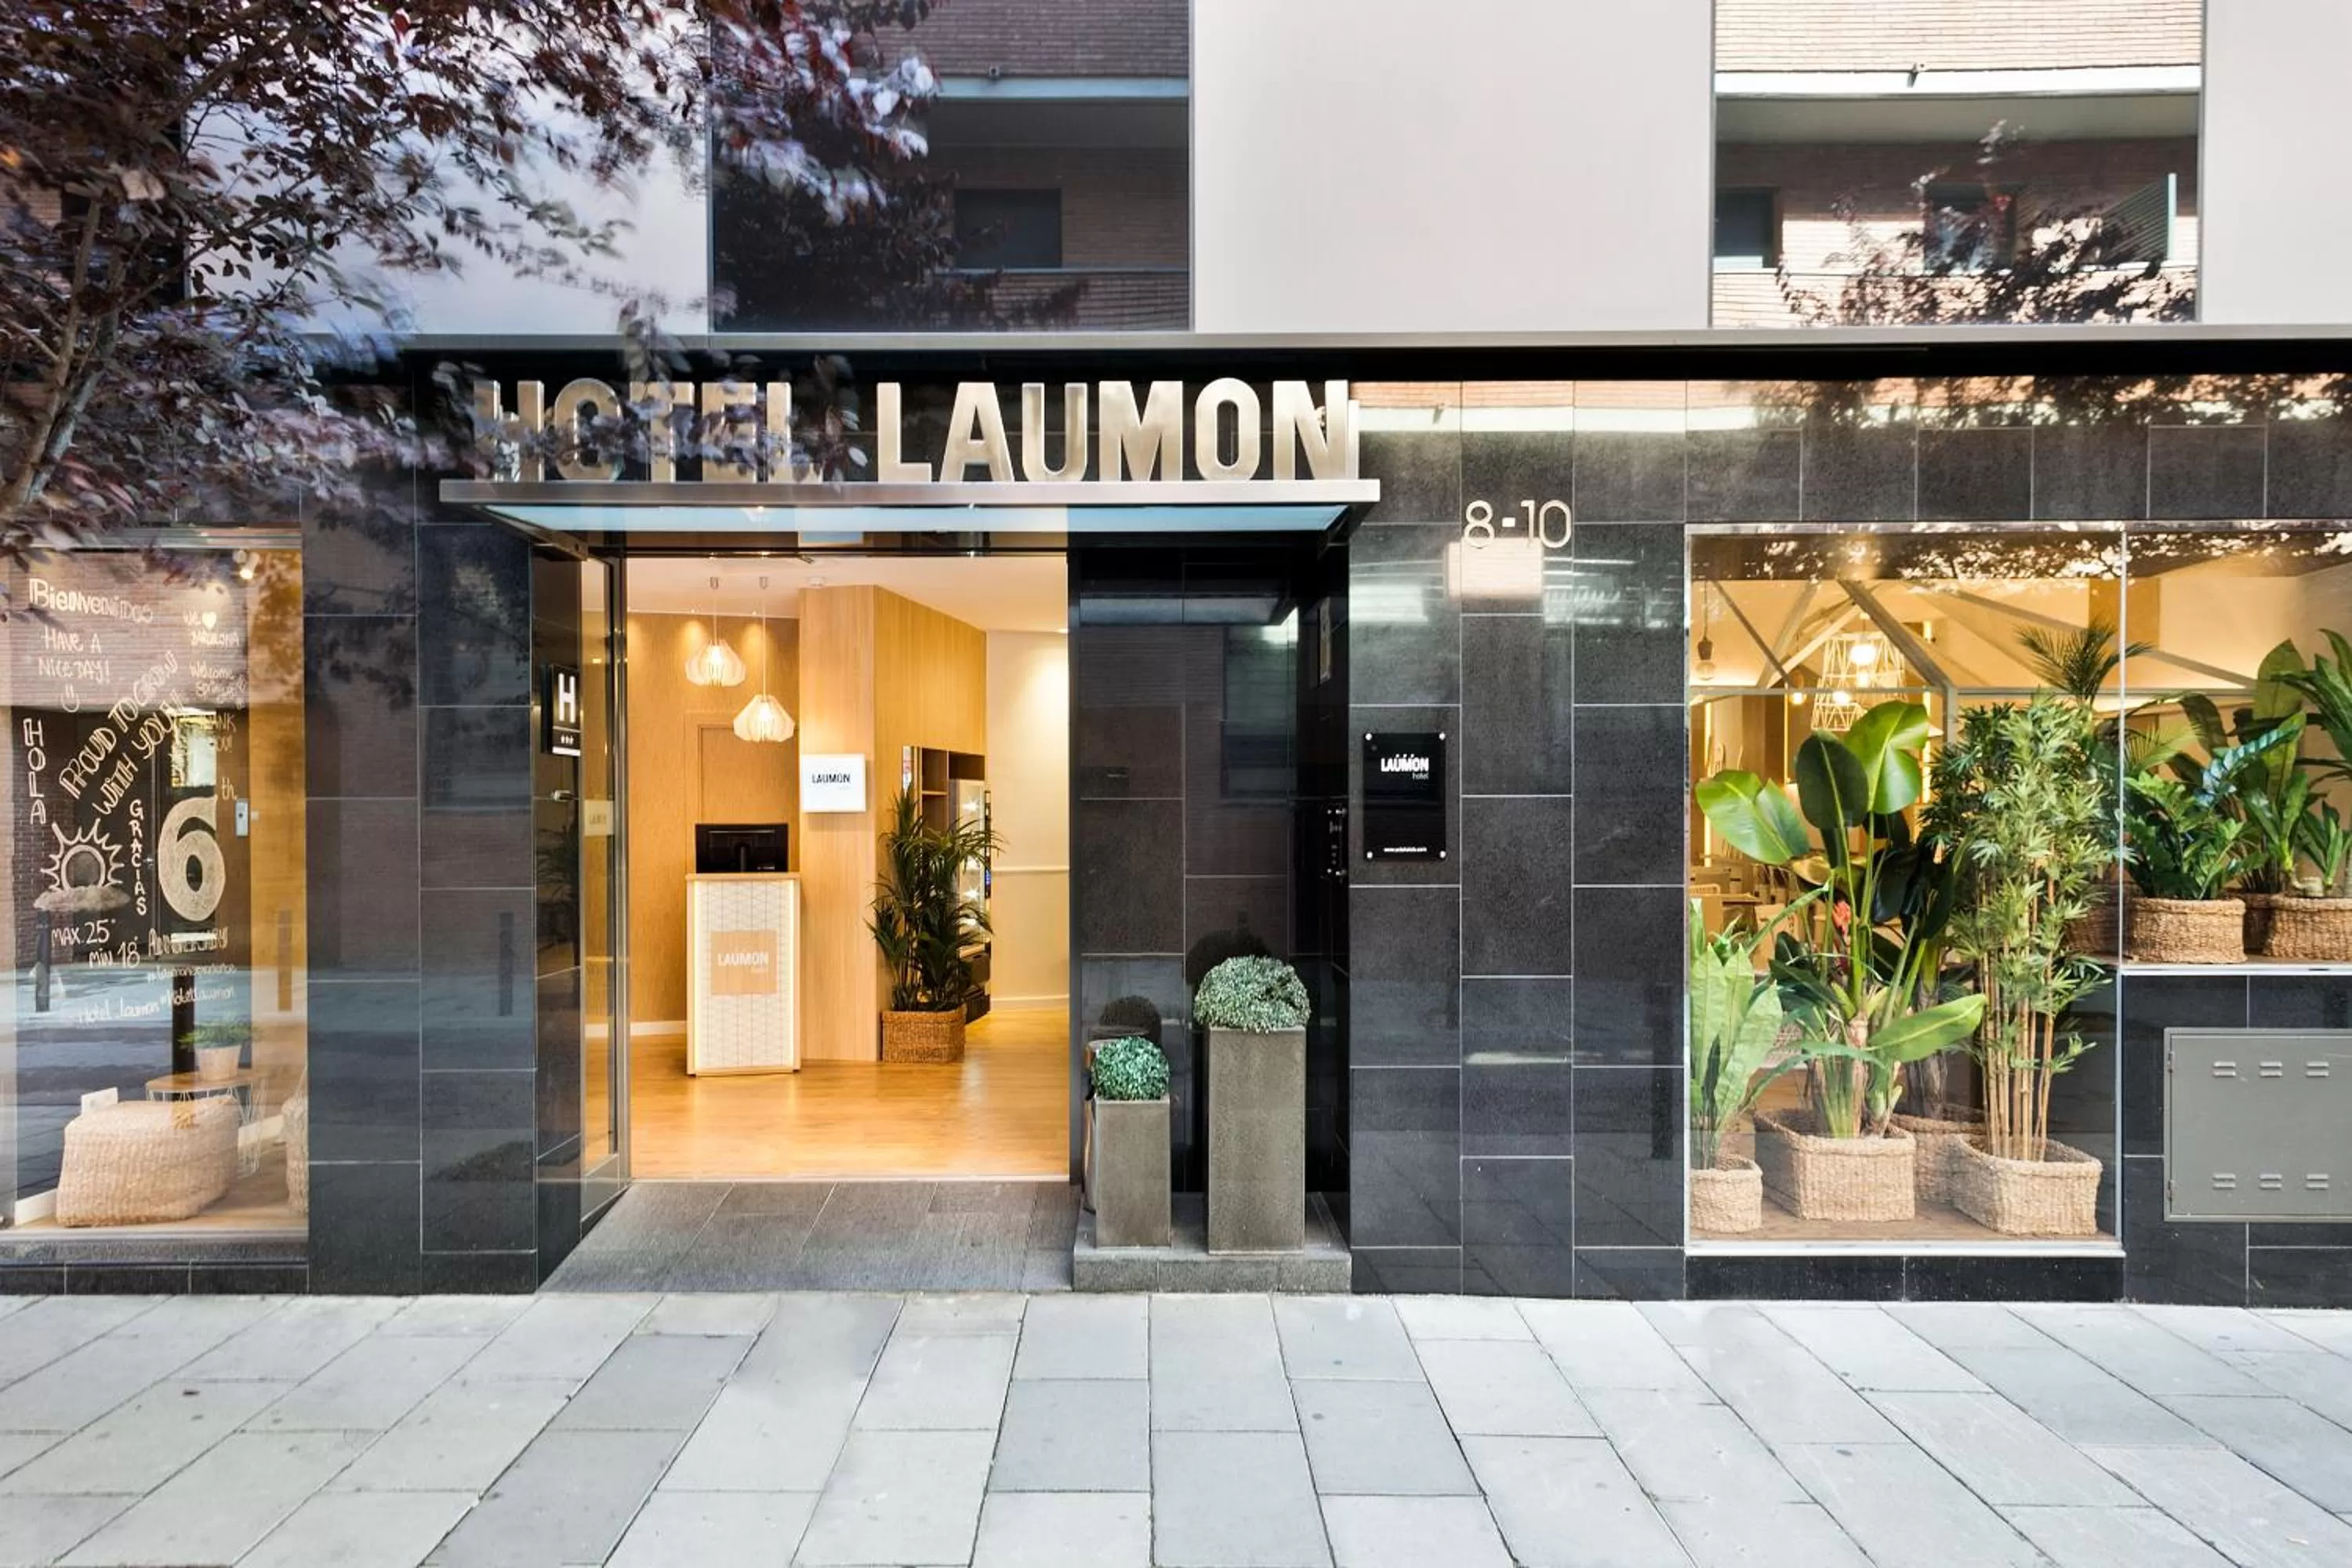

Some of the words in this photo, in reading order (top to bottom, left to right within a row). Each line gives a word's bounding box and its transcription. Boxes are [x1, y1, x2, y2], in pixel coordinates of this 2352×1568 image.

[876, 377, 1352, 483] LAUMON
[1464, 499, 1572, 550] 8-10
[23, 717, 46, 825] HOLA
[811, 772, 851, 784] LAUMON
[1381, 757, 1429, 772] LAUMON
[129, 799, 147, 916] GRACIAS
[717, 951, 769, 967] LAUMON
